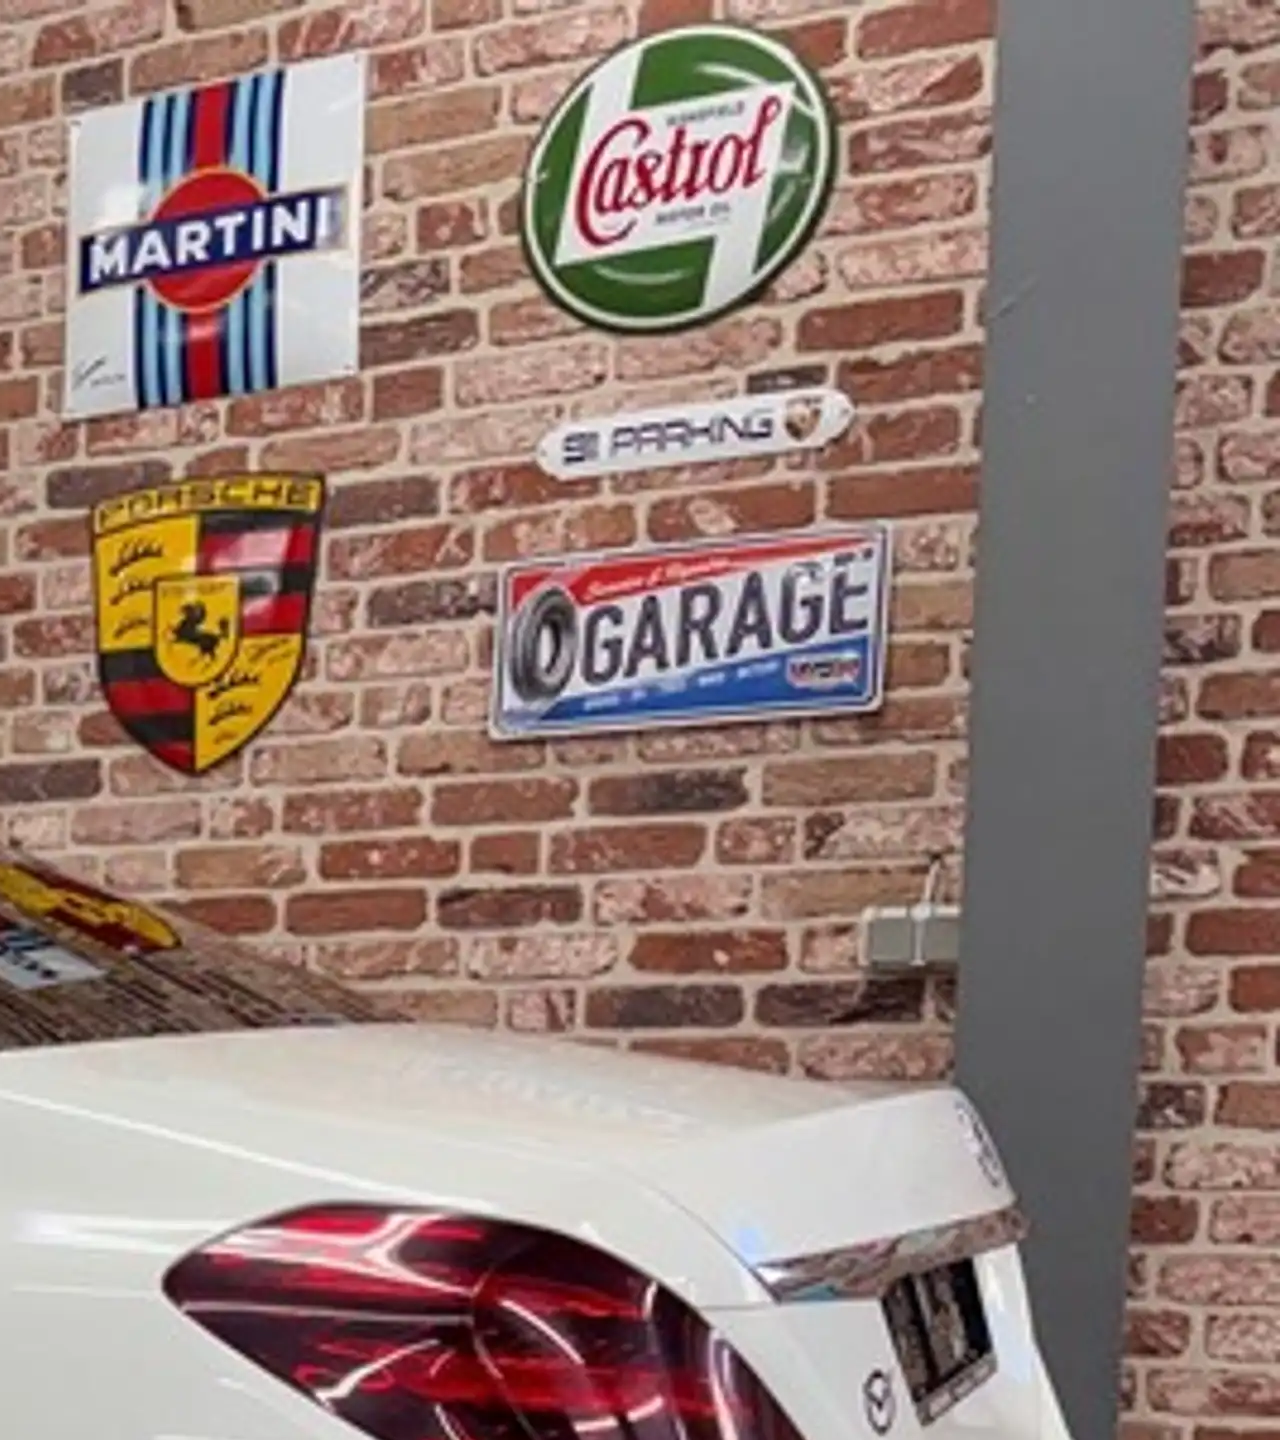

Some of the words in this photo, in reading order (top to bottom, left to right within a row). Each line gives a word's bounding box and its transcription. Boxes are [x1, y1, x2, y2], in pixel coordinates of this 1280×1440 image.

[575, 95, 782, 248] Castrol
[89, 196, 329, 285] MARTINI
[608, 408, 774, 457] PARKING
[99, 479, 316, 529] PORSCHE
[580, 547, 874, 686] GARAGE
